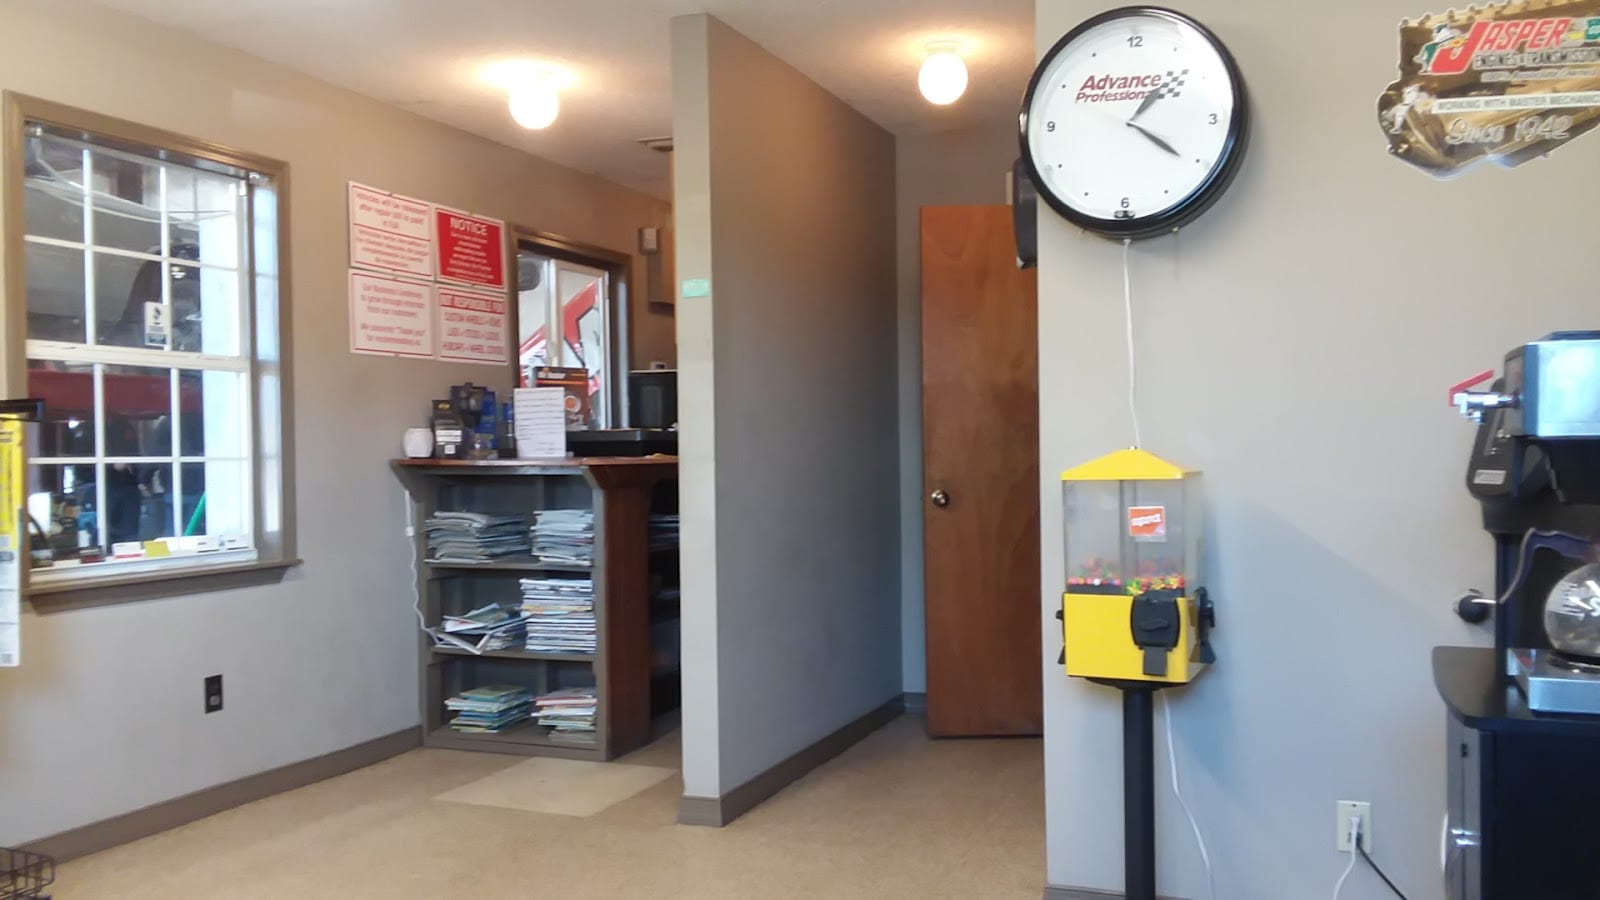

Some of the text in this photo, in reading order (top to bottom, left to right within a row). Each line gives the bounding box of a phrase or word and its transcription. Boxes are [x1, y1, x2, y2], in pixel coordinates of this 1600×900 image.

[1127, 35, 1144, 48] 12
[1430, 17, 1573, 75] JASPER
[1079, 73, 1162, 91] Advance
[1074, 90, 1150, 104] Profession
[1437, 99, 1481, 110] WORKING
[1484, 98, 1505, 109] WITH
[1509, 96, 1547, 107] MASTER
[1208, 113, 1218, 125] 3
[1046, 121, 1056, 132] 9
[1445, 115, 1574, 146] Since 1942
[1120, 197, 1130, 209] 6
[450, 216, 488, 236] NOTICE
